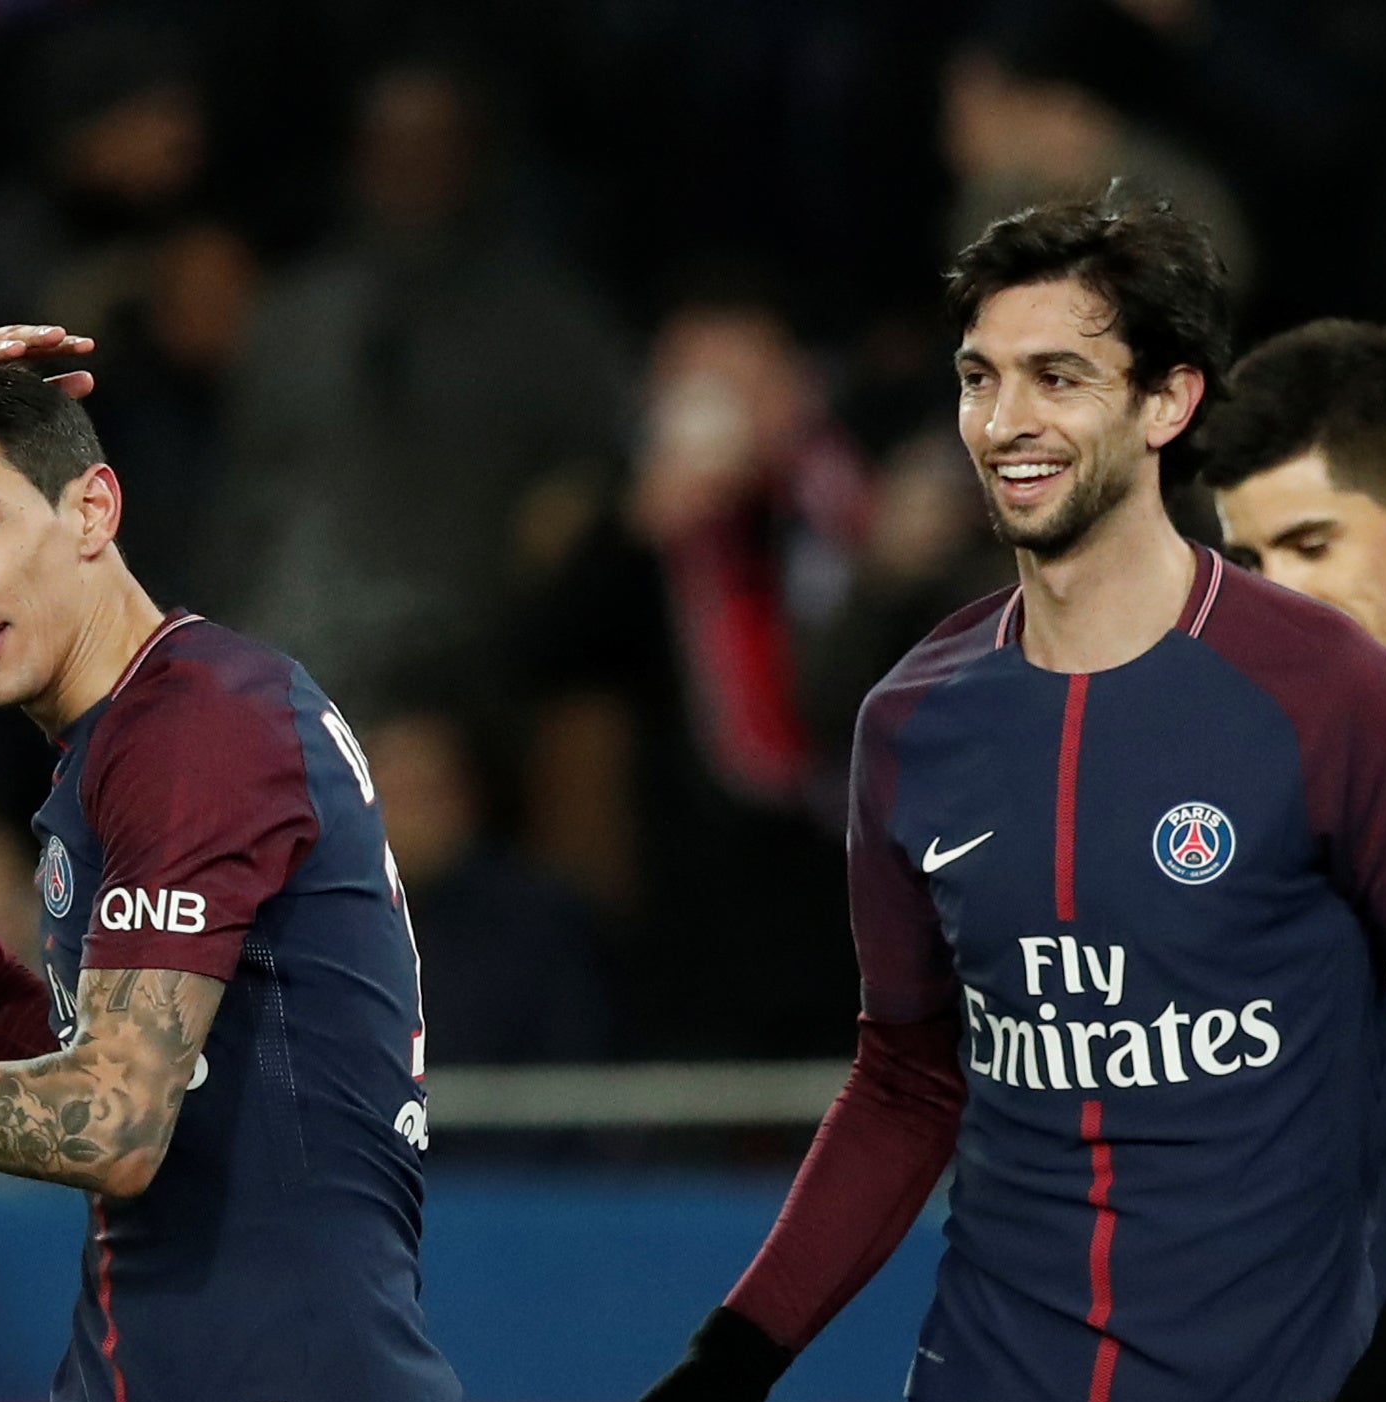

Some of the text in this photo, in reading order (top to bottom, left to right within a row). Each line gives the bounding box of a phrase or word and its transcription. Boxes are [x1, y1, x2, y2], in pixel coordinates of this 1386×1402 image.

[1167, 806, 1222, 828] PARIS
[100, 887, 207, 934] QNB
[1018, 936, 1126, 1006] Fly
[963, 983, 1281, 1090] Emirates
